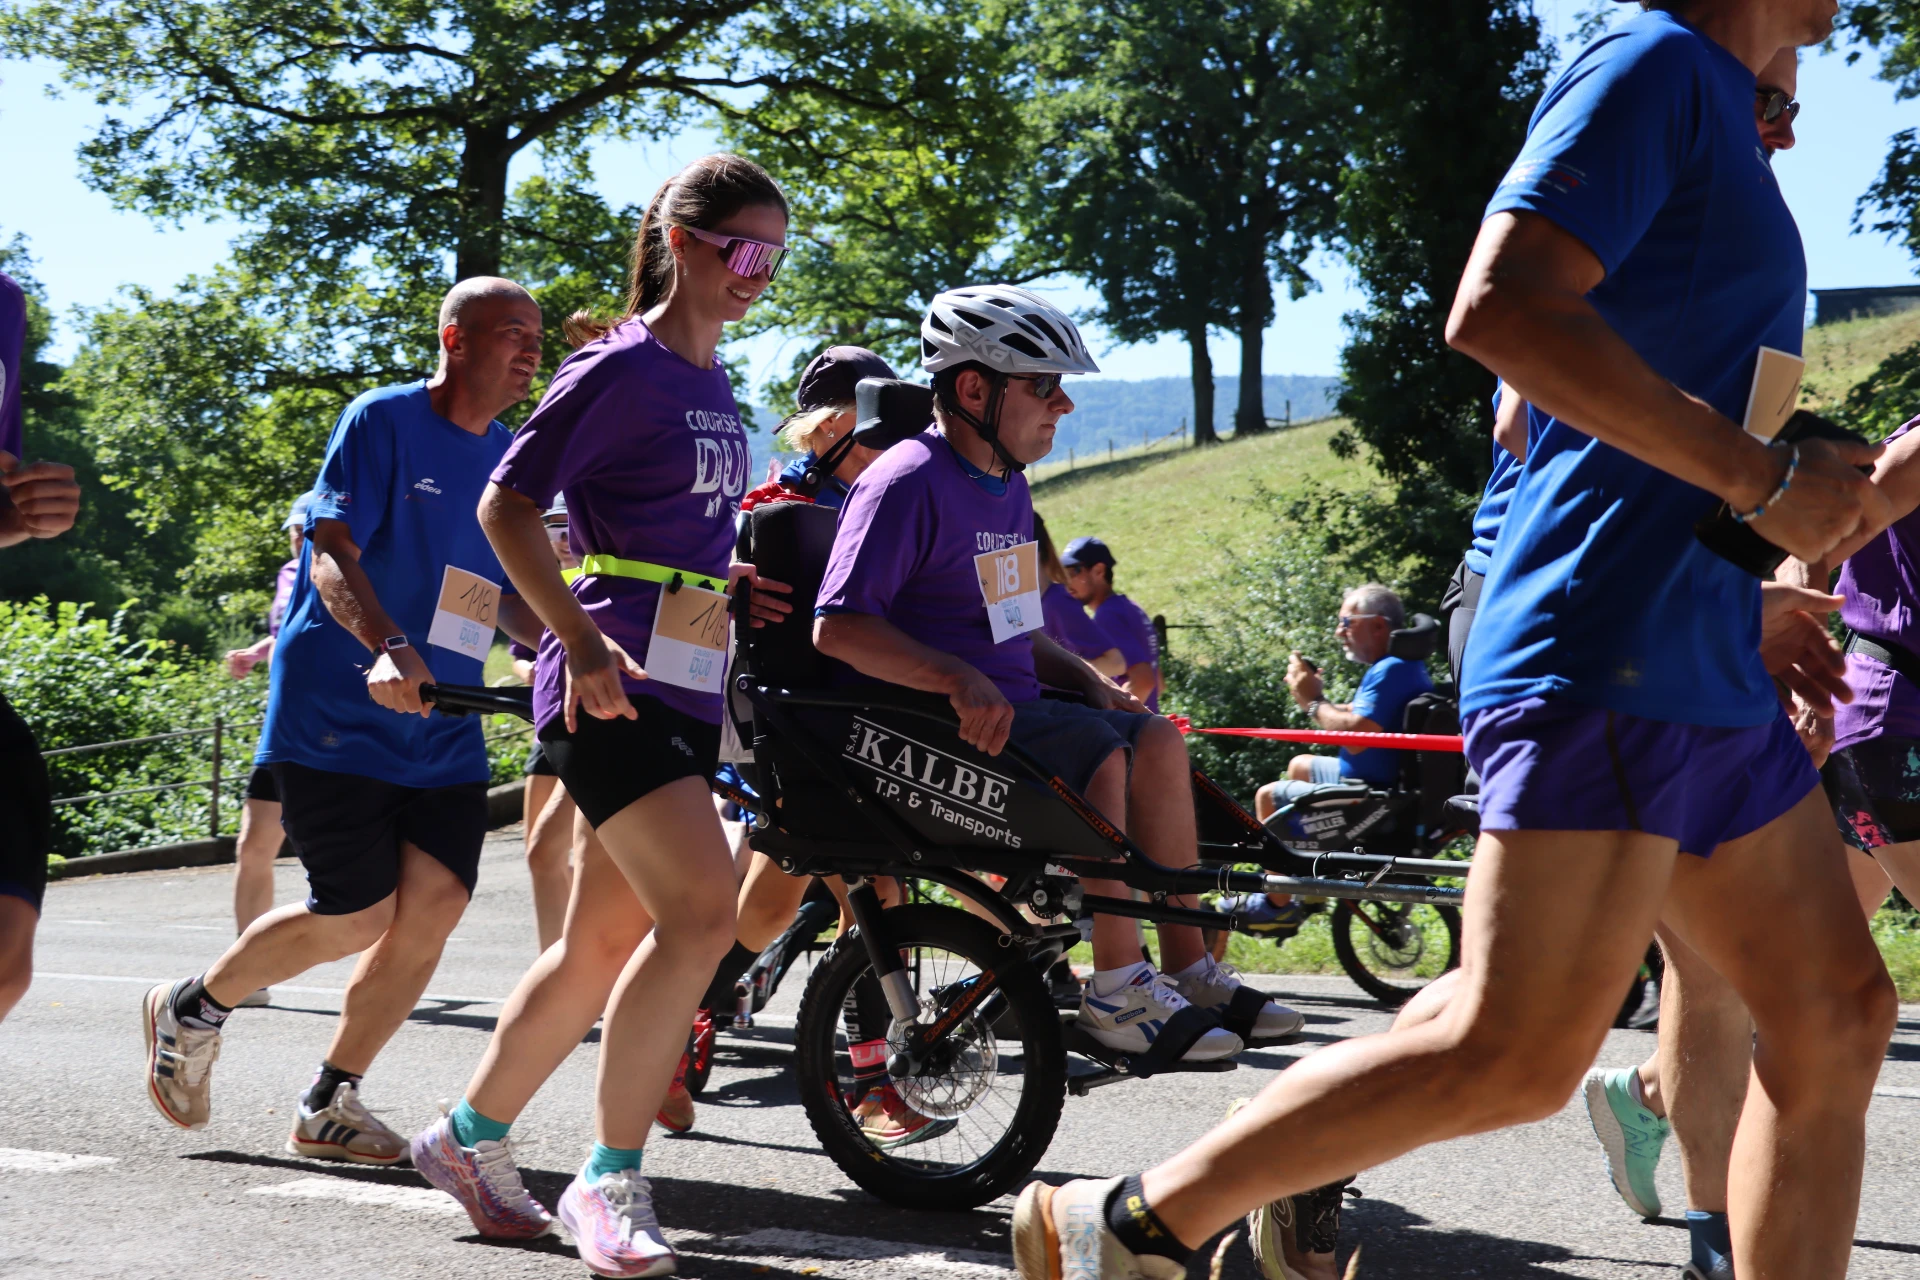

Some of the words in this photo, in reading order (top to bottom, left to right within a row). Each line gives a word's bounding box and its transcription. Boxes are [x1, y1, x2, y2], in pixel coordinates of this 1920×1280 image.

[684, 409, 740, 434] COURSE
[995, 553, 1020, 596] 118
[460, 582, 492, 622] 118
[689, 600, 725, 646] 118
[689, 656, 712, 677] DUO
[846, 722, 861, 753] S.A.S
[857, 726, 1009, 814] KALBE
[875, 776, 900, 802] T.P.
[908, 791, 922, 808] &
[930, 799, 1022, 849] Transports
[1117, 1008, 1144, 1023] Reebok
[1066, 1204, 1097, 1280] HOK
